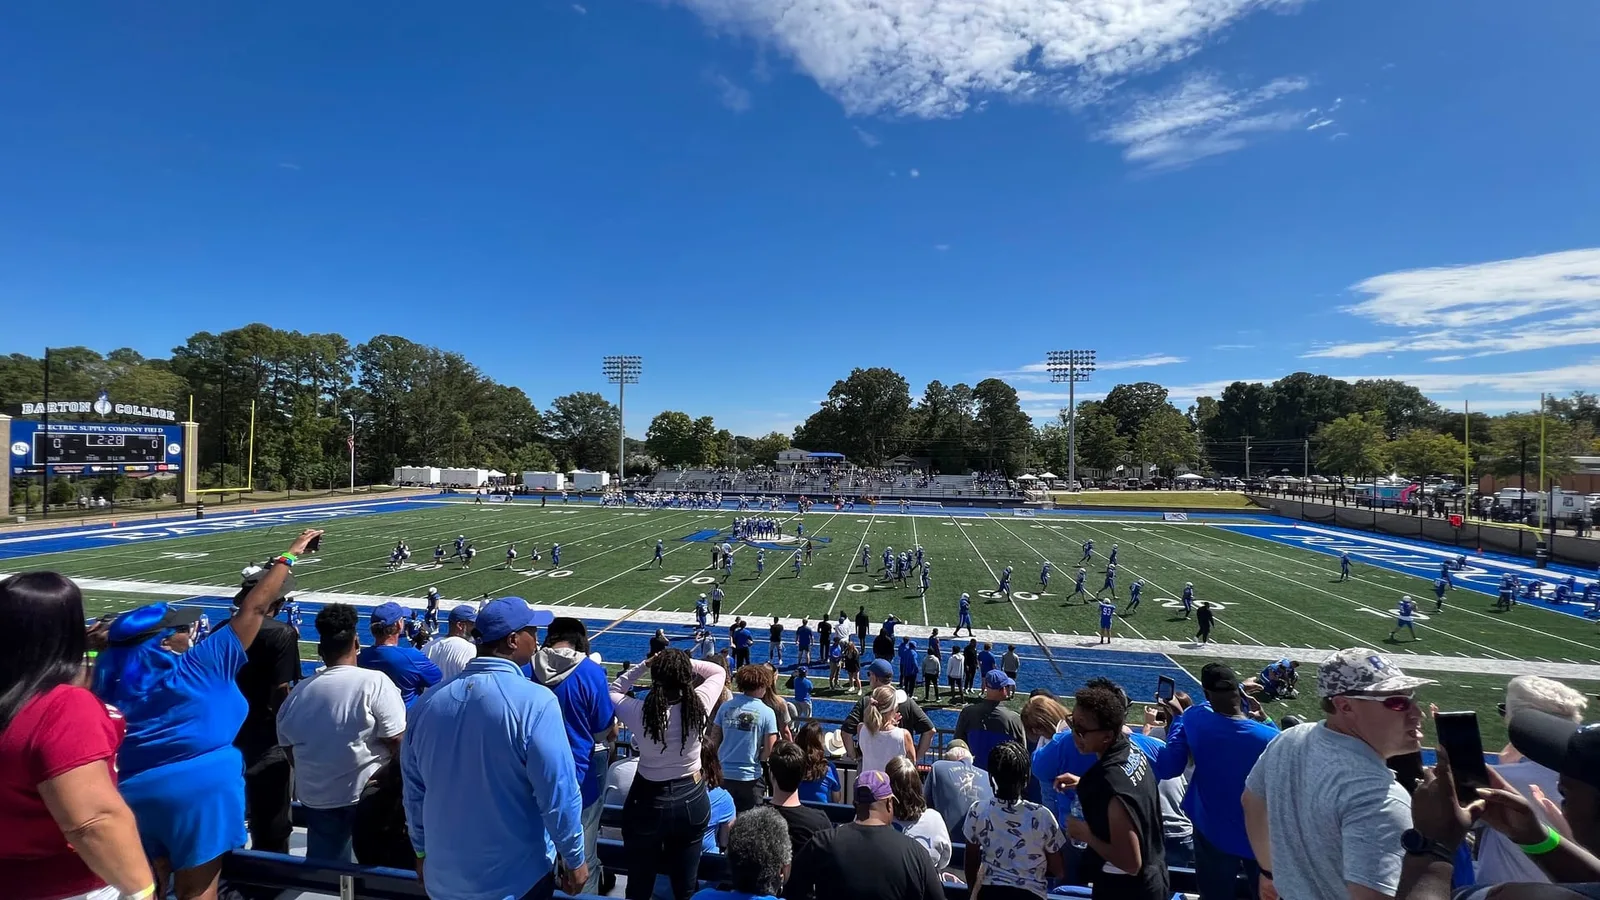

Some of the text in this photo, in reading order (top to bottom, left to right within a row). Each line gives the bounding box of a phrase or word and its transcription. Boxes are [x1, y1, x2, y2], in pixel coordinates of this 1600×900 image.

[21, 401, 175, 421] BARTON COLLEGE
[53, 438, 61, 448] 0
[97, 435, 123, 445] 2:28
[151, 439, 158, 448] 0
[517, 569, 574, 578] 40
[659, 575, 716, 585] 50
[812, 582, 870, 592] 40
[977, 589, 1040, 601] 30
[1153, 597, 1226, 610] 20
[1102, 607, 1112, 616] 93
